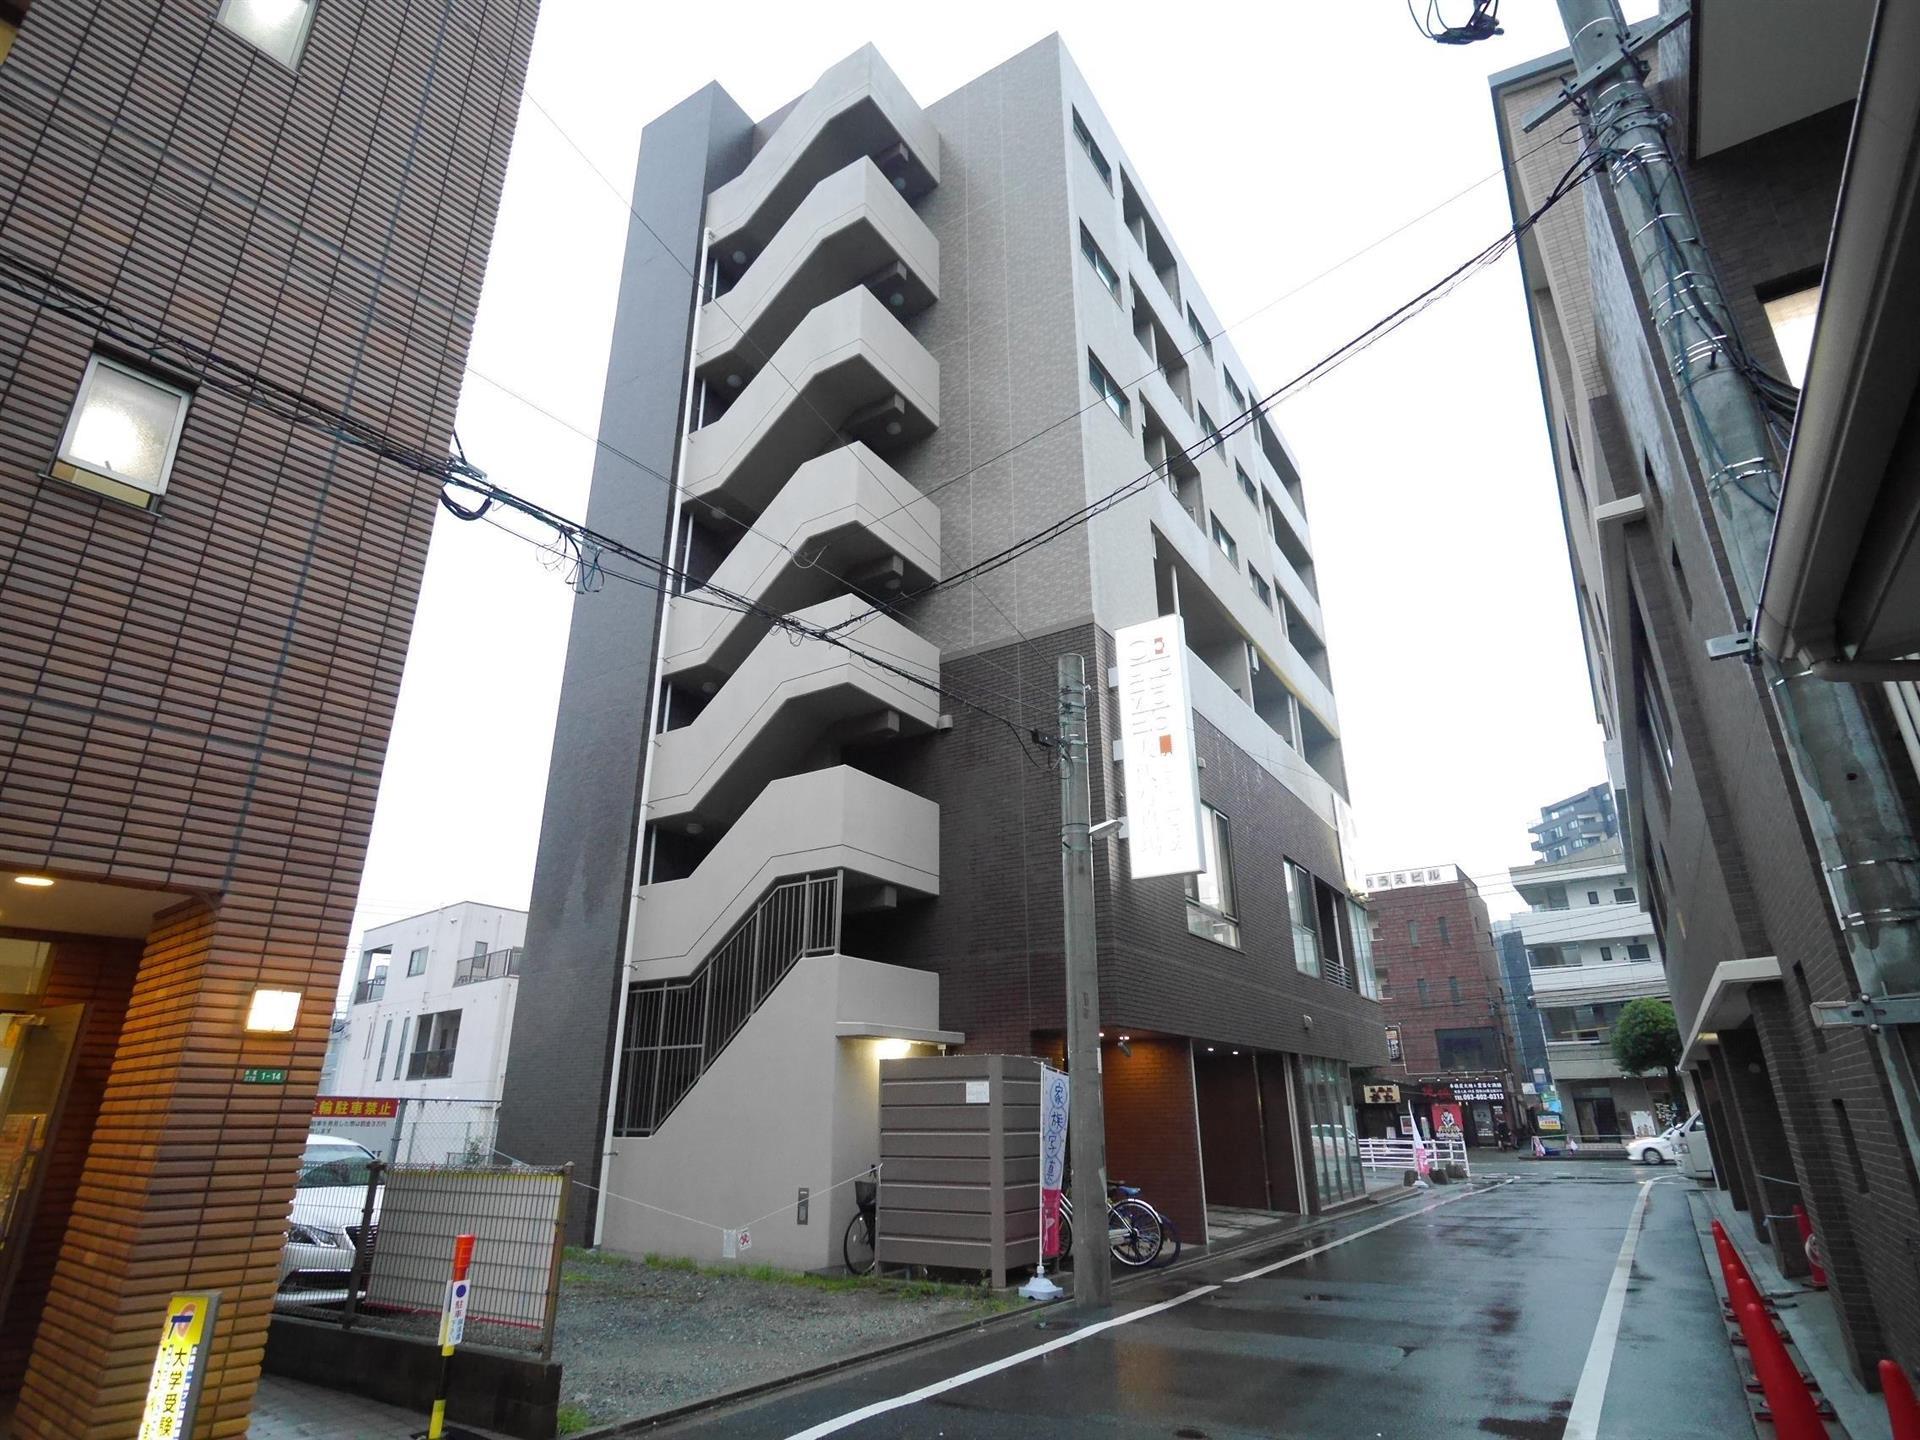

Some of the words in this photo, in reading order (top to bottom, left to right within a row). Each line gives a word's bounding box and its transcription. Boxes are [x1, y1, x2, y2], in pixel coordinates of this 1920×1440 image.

[261, 1072, 281, 1080] 1-14
[159, 1347, 187, 1437] 大学受験
